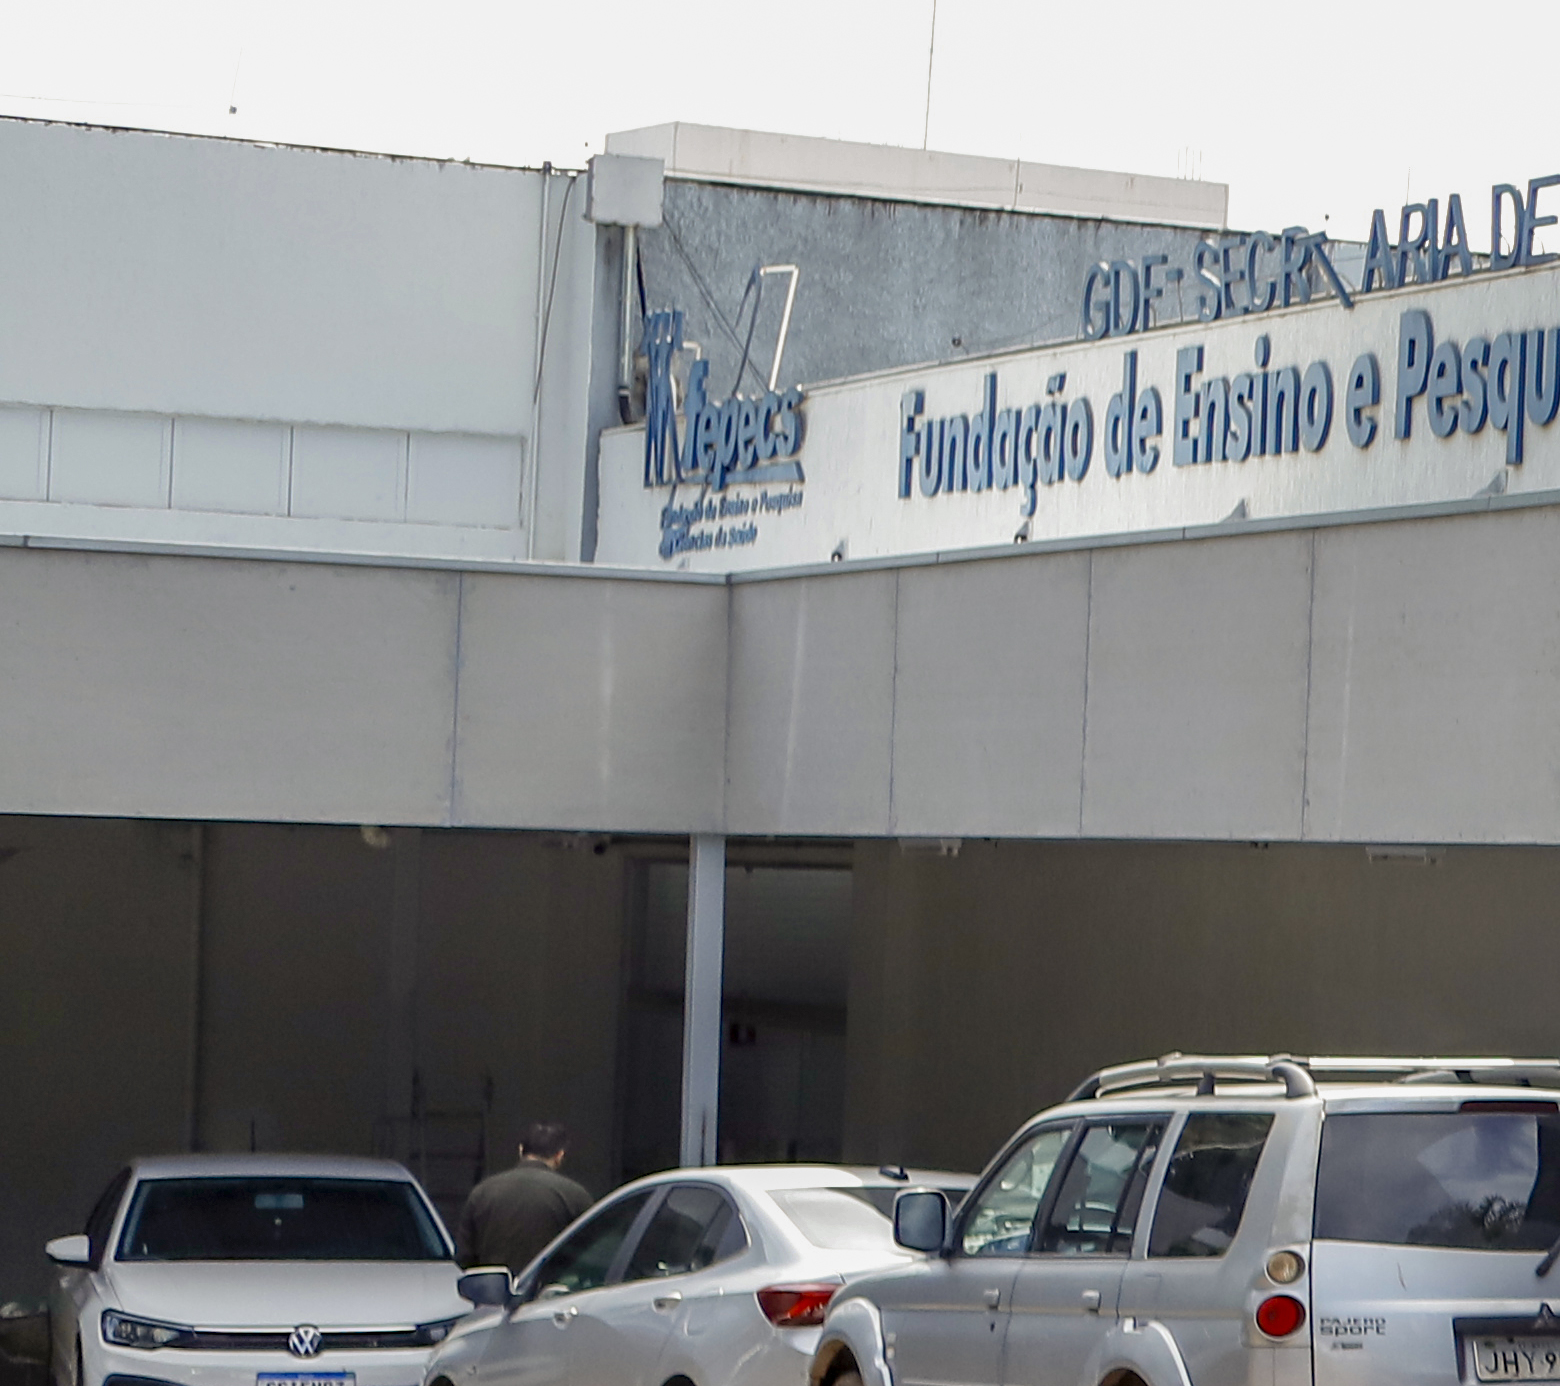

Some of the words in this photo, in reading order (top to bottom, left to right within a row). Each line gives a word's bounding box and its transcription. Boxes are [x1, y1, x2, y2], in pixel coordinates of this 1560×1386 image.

[899, 372, 1093, 517] Fundação
[1104, 349, 1162, 479] de
[1172, 333, 1333, 466] Ensino
[1346, 353, 1380, 450] e
